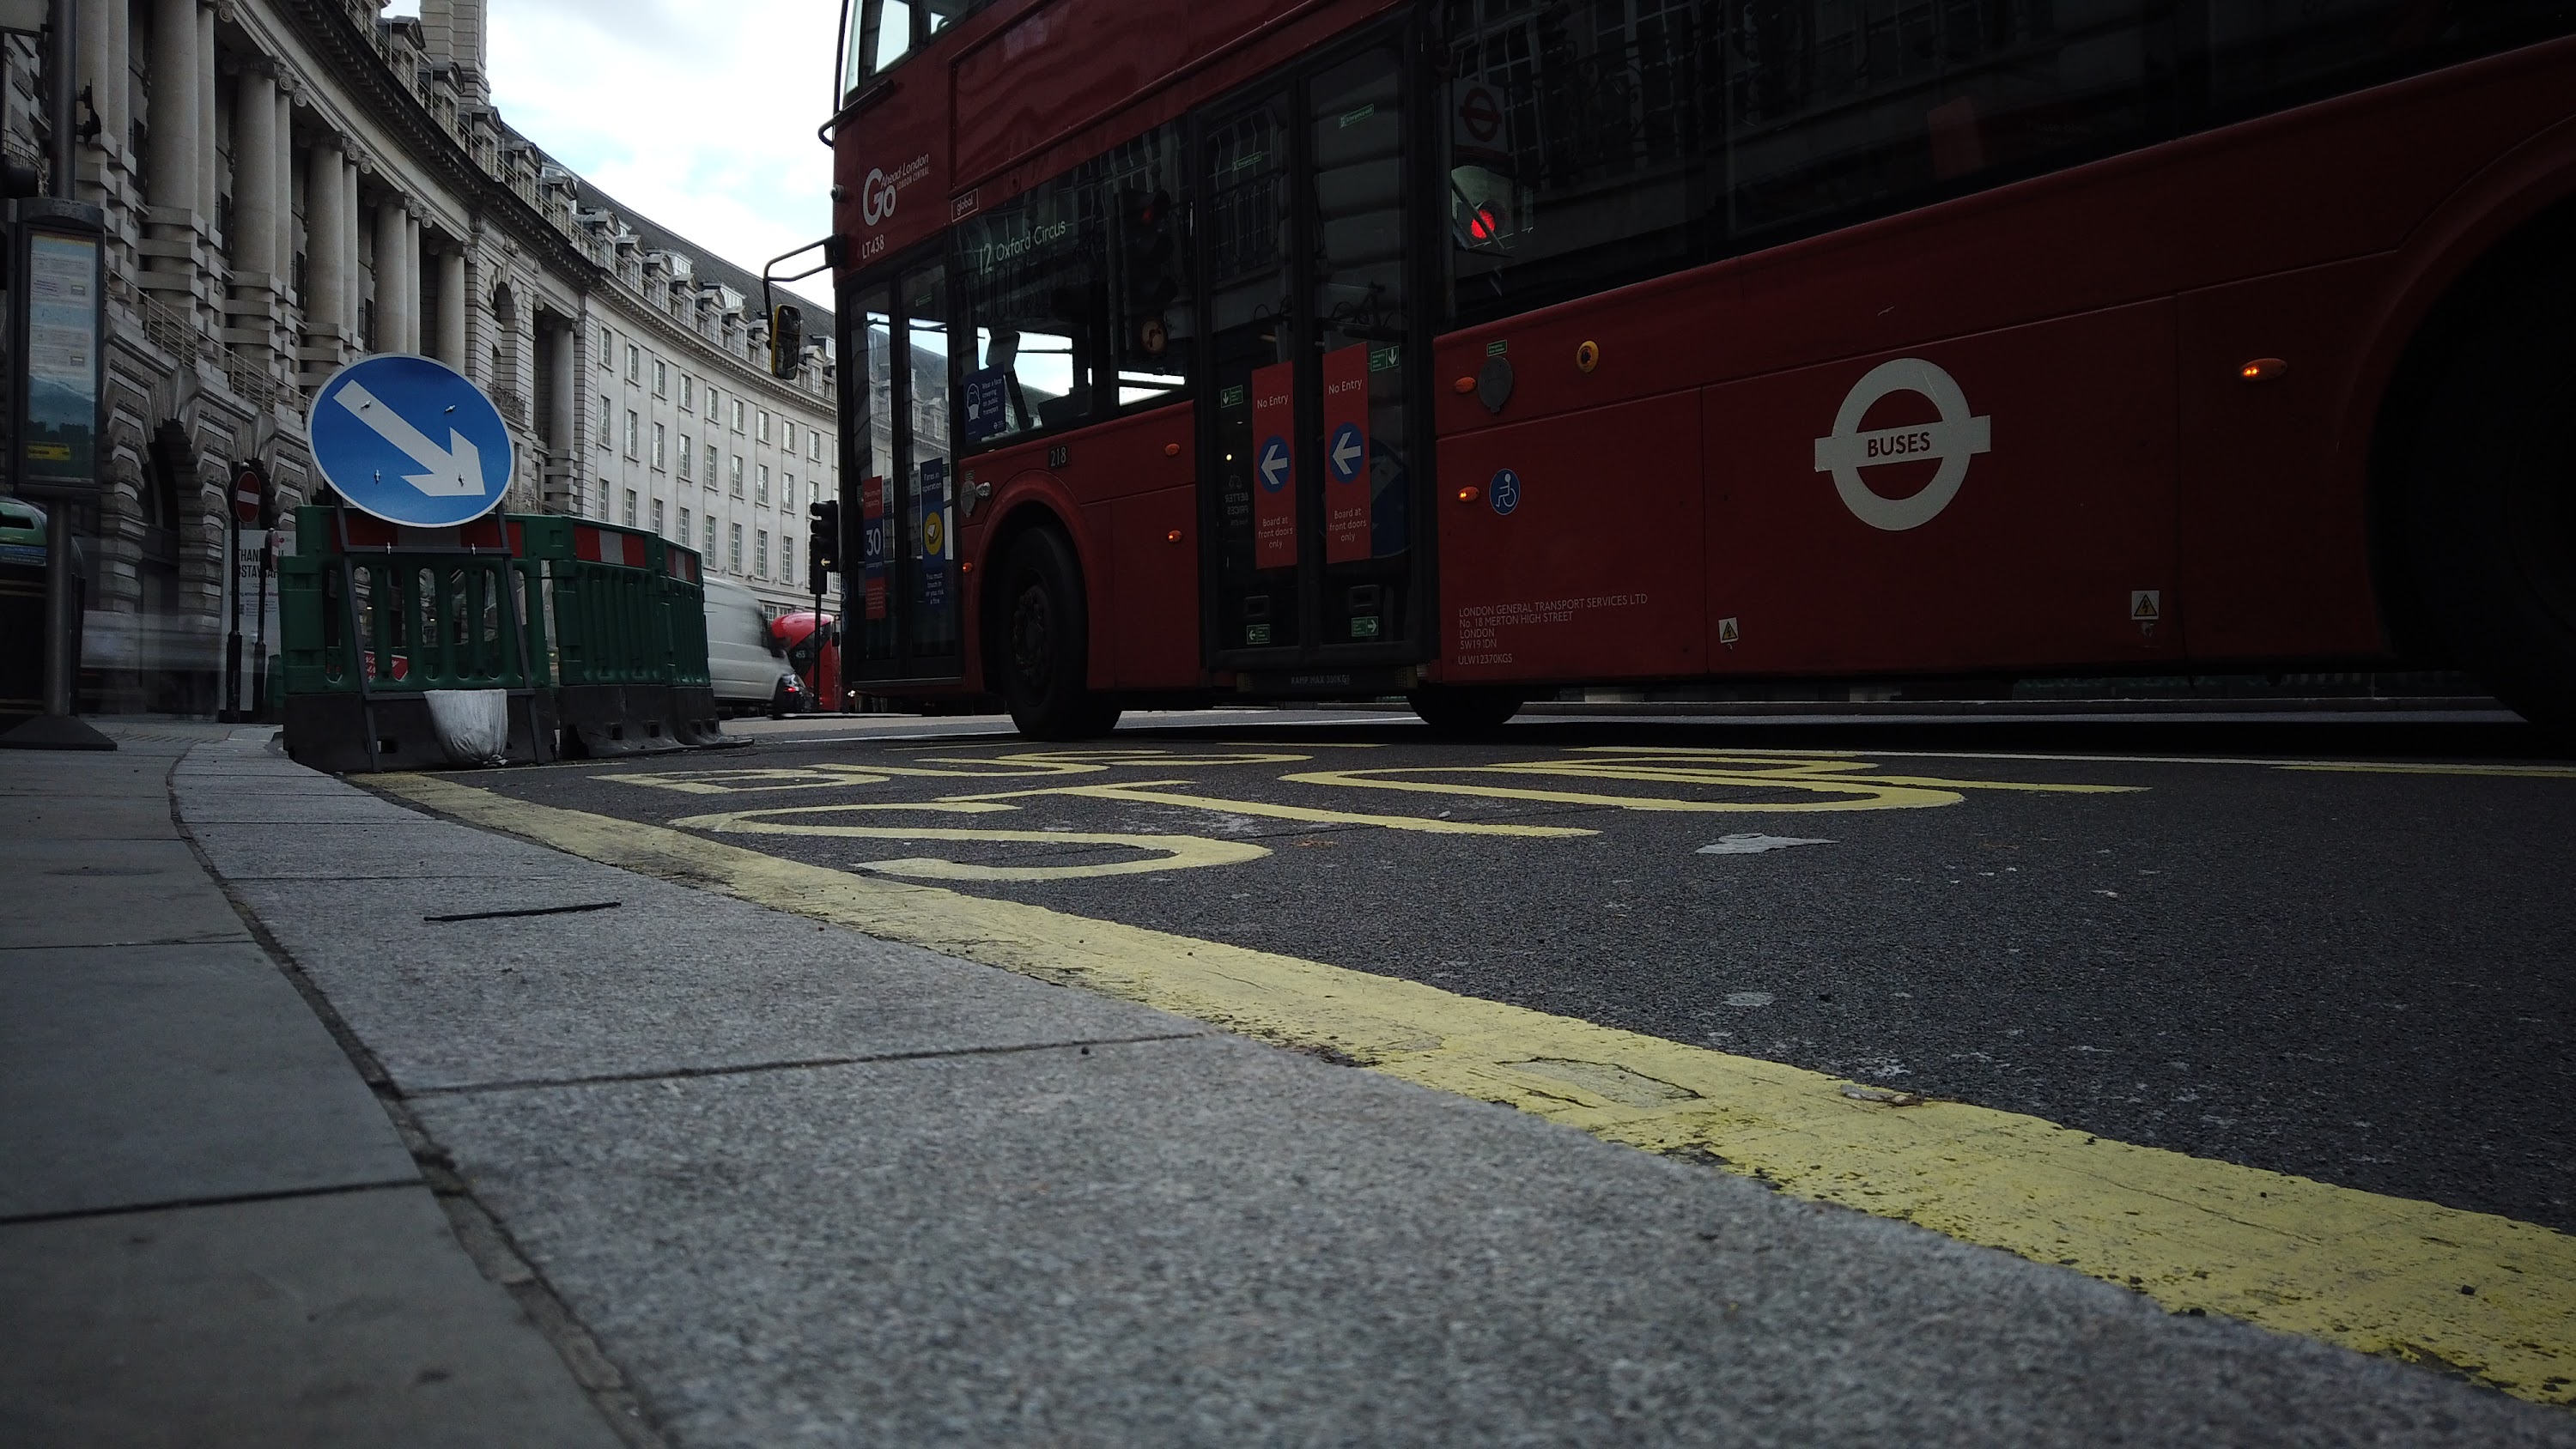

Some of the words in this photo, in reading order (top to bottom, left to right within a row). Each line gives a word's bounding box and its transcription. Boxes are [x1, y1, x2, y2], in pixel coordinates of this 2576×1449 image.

[863, 167, 896, 227] Go
[956, 194, 974, 216] global
[861, 233, 885, 259] LT438
[980, 242, 993, 275] 12
[996, 230, 1031, 261] Oxford
[1034, 220, 1066, 246] Circus
[1328, 384, 1340, 395] No
[1341, 379, 1363, 391] Entry
[1256, 398, 1268, 409] No
[1269, 394, 1289, 407] Entry
[1867, 431, 1931, 458] BUSES
[1050, 446, 1067, 467] 218
[1262, 516, 1280, 527] Board
[1281, 516, 1289, 524] at
[1334, 508, 1353, 519] Board
[1354, 508, 1362, 517] at
[1258, 530, 1274, 539] front
[1275, 527, 1293, 537] doors
[1329, 522, 1346, 531] front
[1347, 519, 1367, 529] doors
[866, 528, 881, 556] 30
[1268, 539, 1283, 549] only
[1340, 531, 1356, 543] only
[1459, 605, 1494, 617] LONDON
[1496, 603, 1532, 615] GENERAL
[1534, 598, 1585, 611] TRANSPORT
[1587, 595, 1628, 609] SERVICES
[1630, 593, 1649, 606] LTD
[1459, 619, 1473, 627] No.
[1474, 618, 1484, 627] 18
[1485, 615, 1519, 626] MERTON
[1521, 614, 1541, 624] HIGH
[1542, 610, 1574, 622] STREET
[1460, 627, 1496, 640] LONDON
[1460, 640, 1481, 650] SW19
[1457, 653, 1514, 665] ULW12370KGS
[586, 749, 1314, 794] BUS
[667, 756, 2153, 882] STOP
